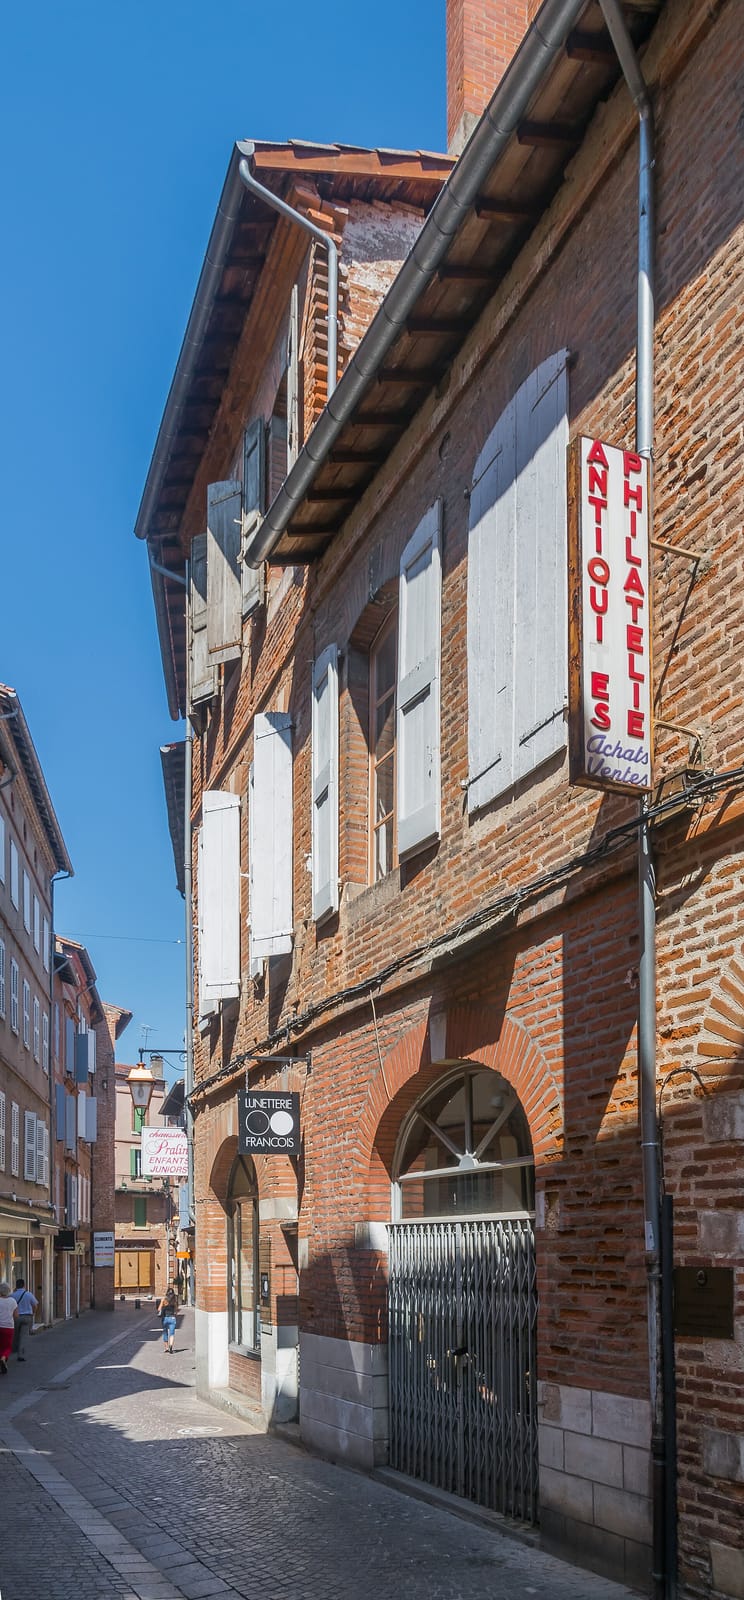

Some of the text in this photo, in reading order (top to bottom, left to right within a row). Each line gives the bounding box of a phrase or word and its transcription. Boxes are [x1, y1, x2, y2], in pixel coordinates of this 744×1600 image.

[587, 438, 611, 732] ANTIQUIES
[623, 450, 645, 739] PHILATELIE
[587, 735, 648, 765] Achats
[587, 757, 648, 787] Ventes
[245, 1098, 292, 1110] LUNETTERIE
[245, 1136, 295, 1148] FRANCOIS
